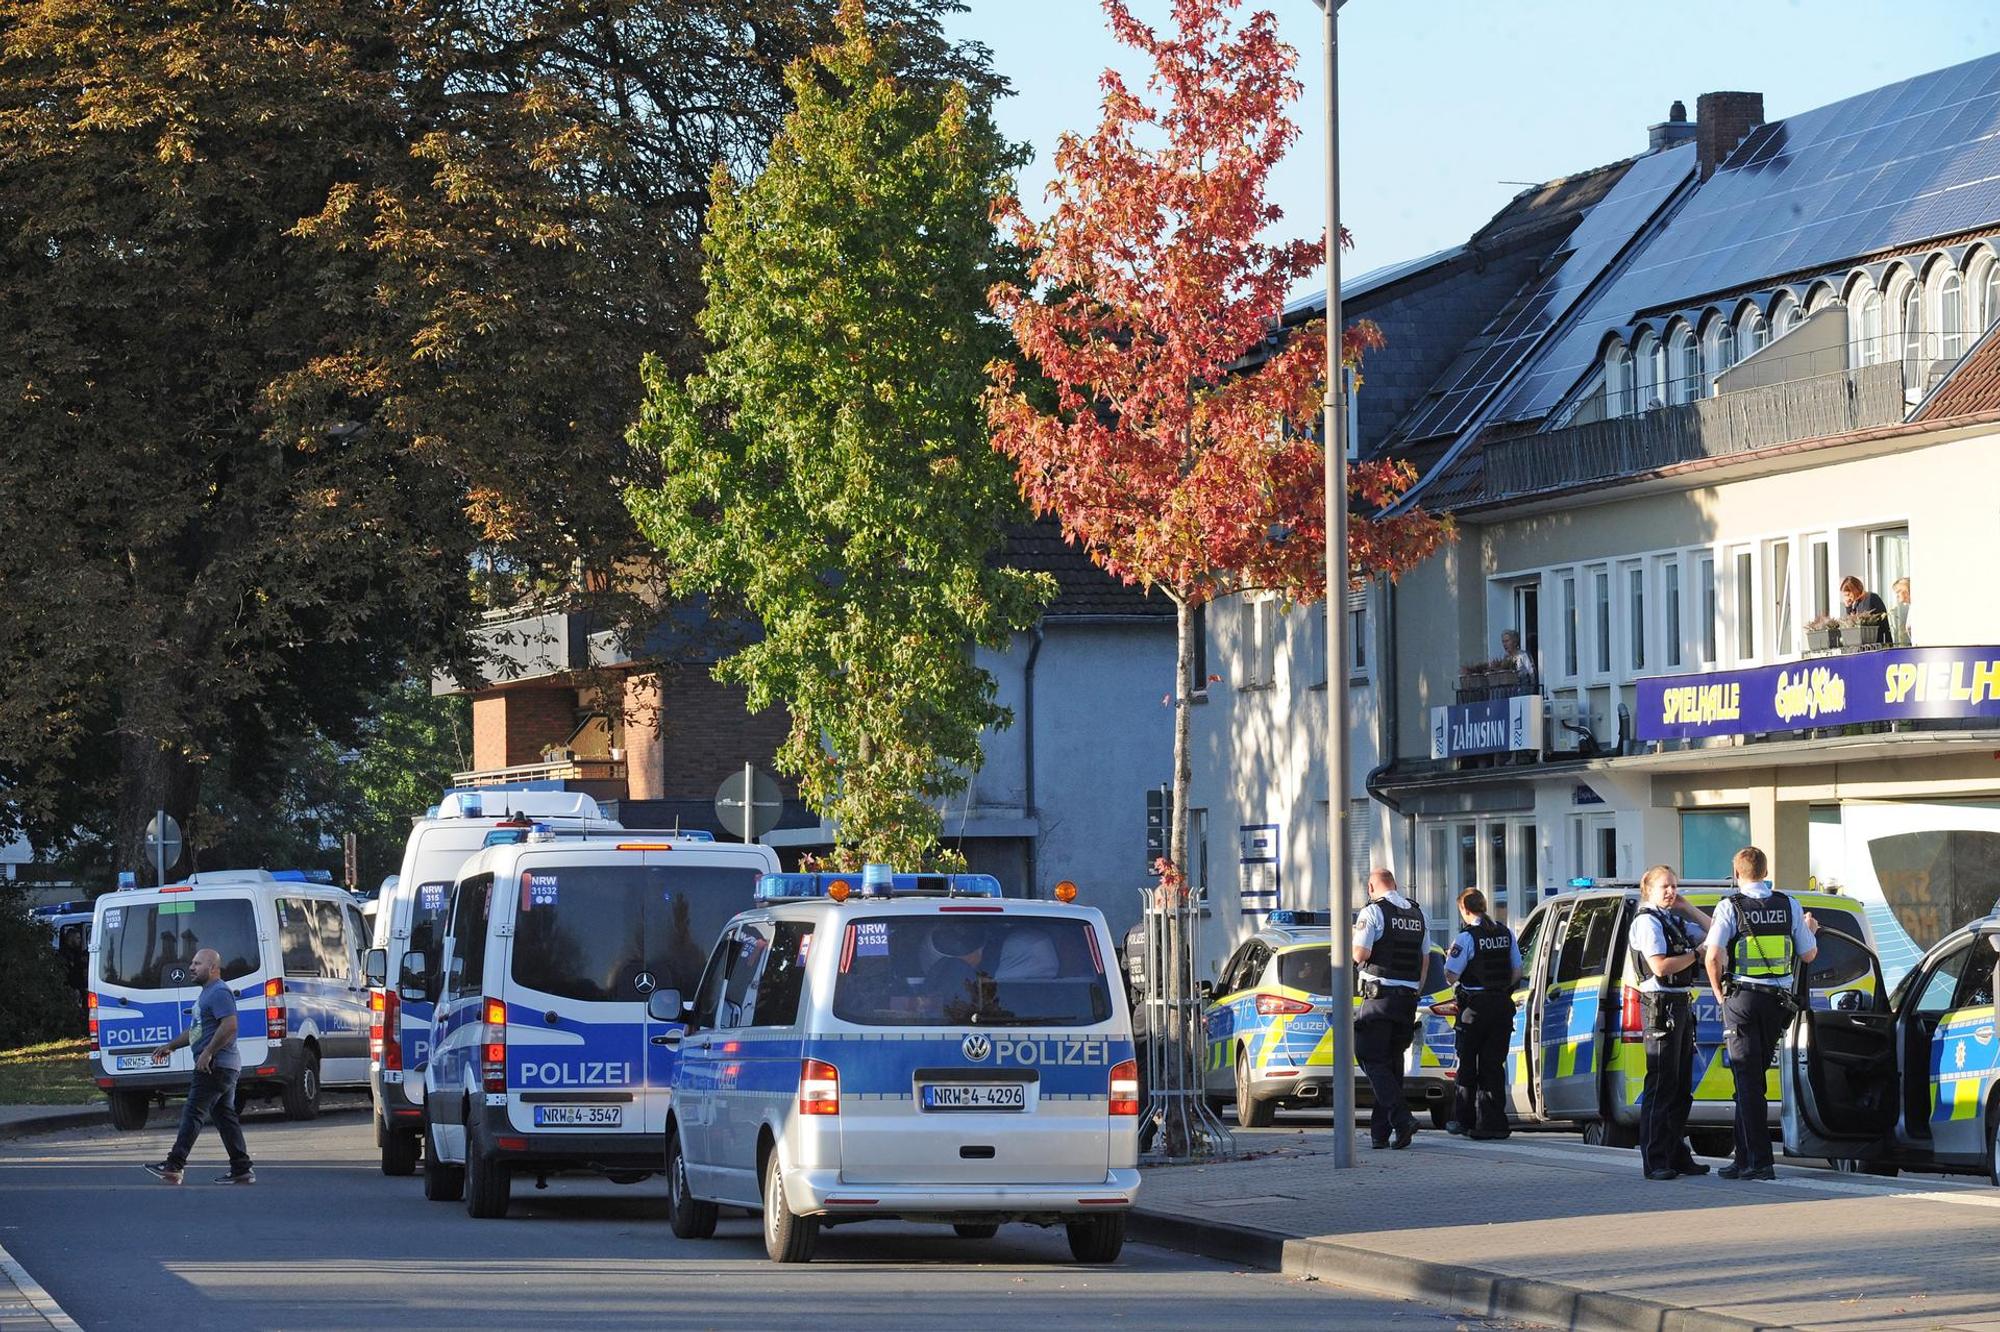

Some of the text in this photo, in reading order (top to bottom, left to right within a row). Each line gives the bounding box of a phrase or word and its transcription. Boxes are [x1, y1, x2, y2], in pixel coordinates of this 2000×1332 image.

[1663, 682, 1740, 726] SPIELHALLE
[531, 876, 557, 885] NRW
[421, 885, 443, 893] NRW
[531, 887, 557, 895] 31532
[1391, 917, 1422, 931] POLIZEI
[1743, 910, 1787, 925] POLIZEI
[857, 924, 887, 934] NRW
[857, 935, 888, 945] 31532
[1286, 1021, 1326, 1030] POLIZEI
[107, 1026, 172, 1044] POLIZEI
[996, 1041, 1108, 1065] POLIZEI
[521, 1062, 630, 1084] POLIZEI
[934, 1088, 1022, 1104] NRW 4-4296
[543, 1108, 619, 1122] NRW 4-3547
